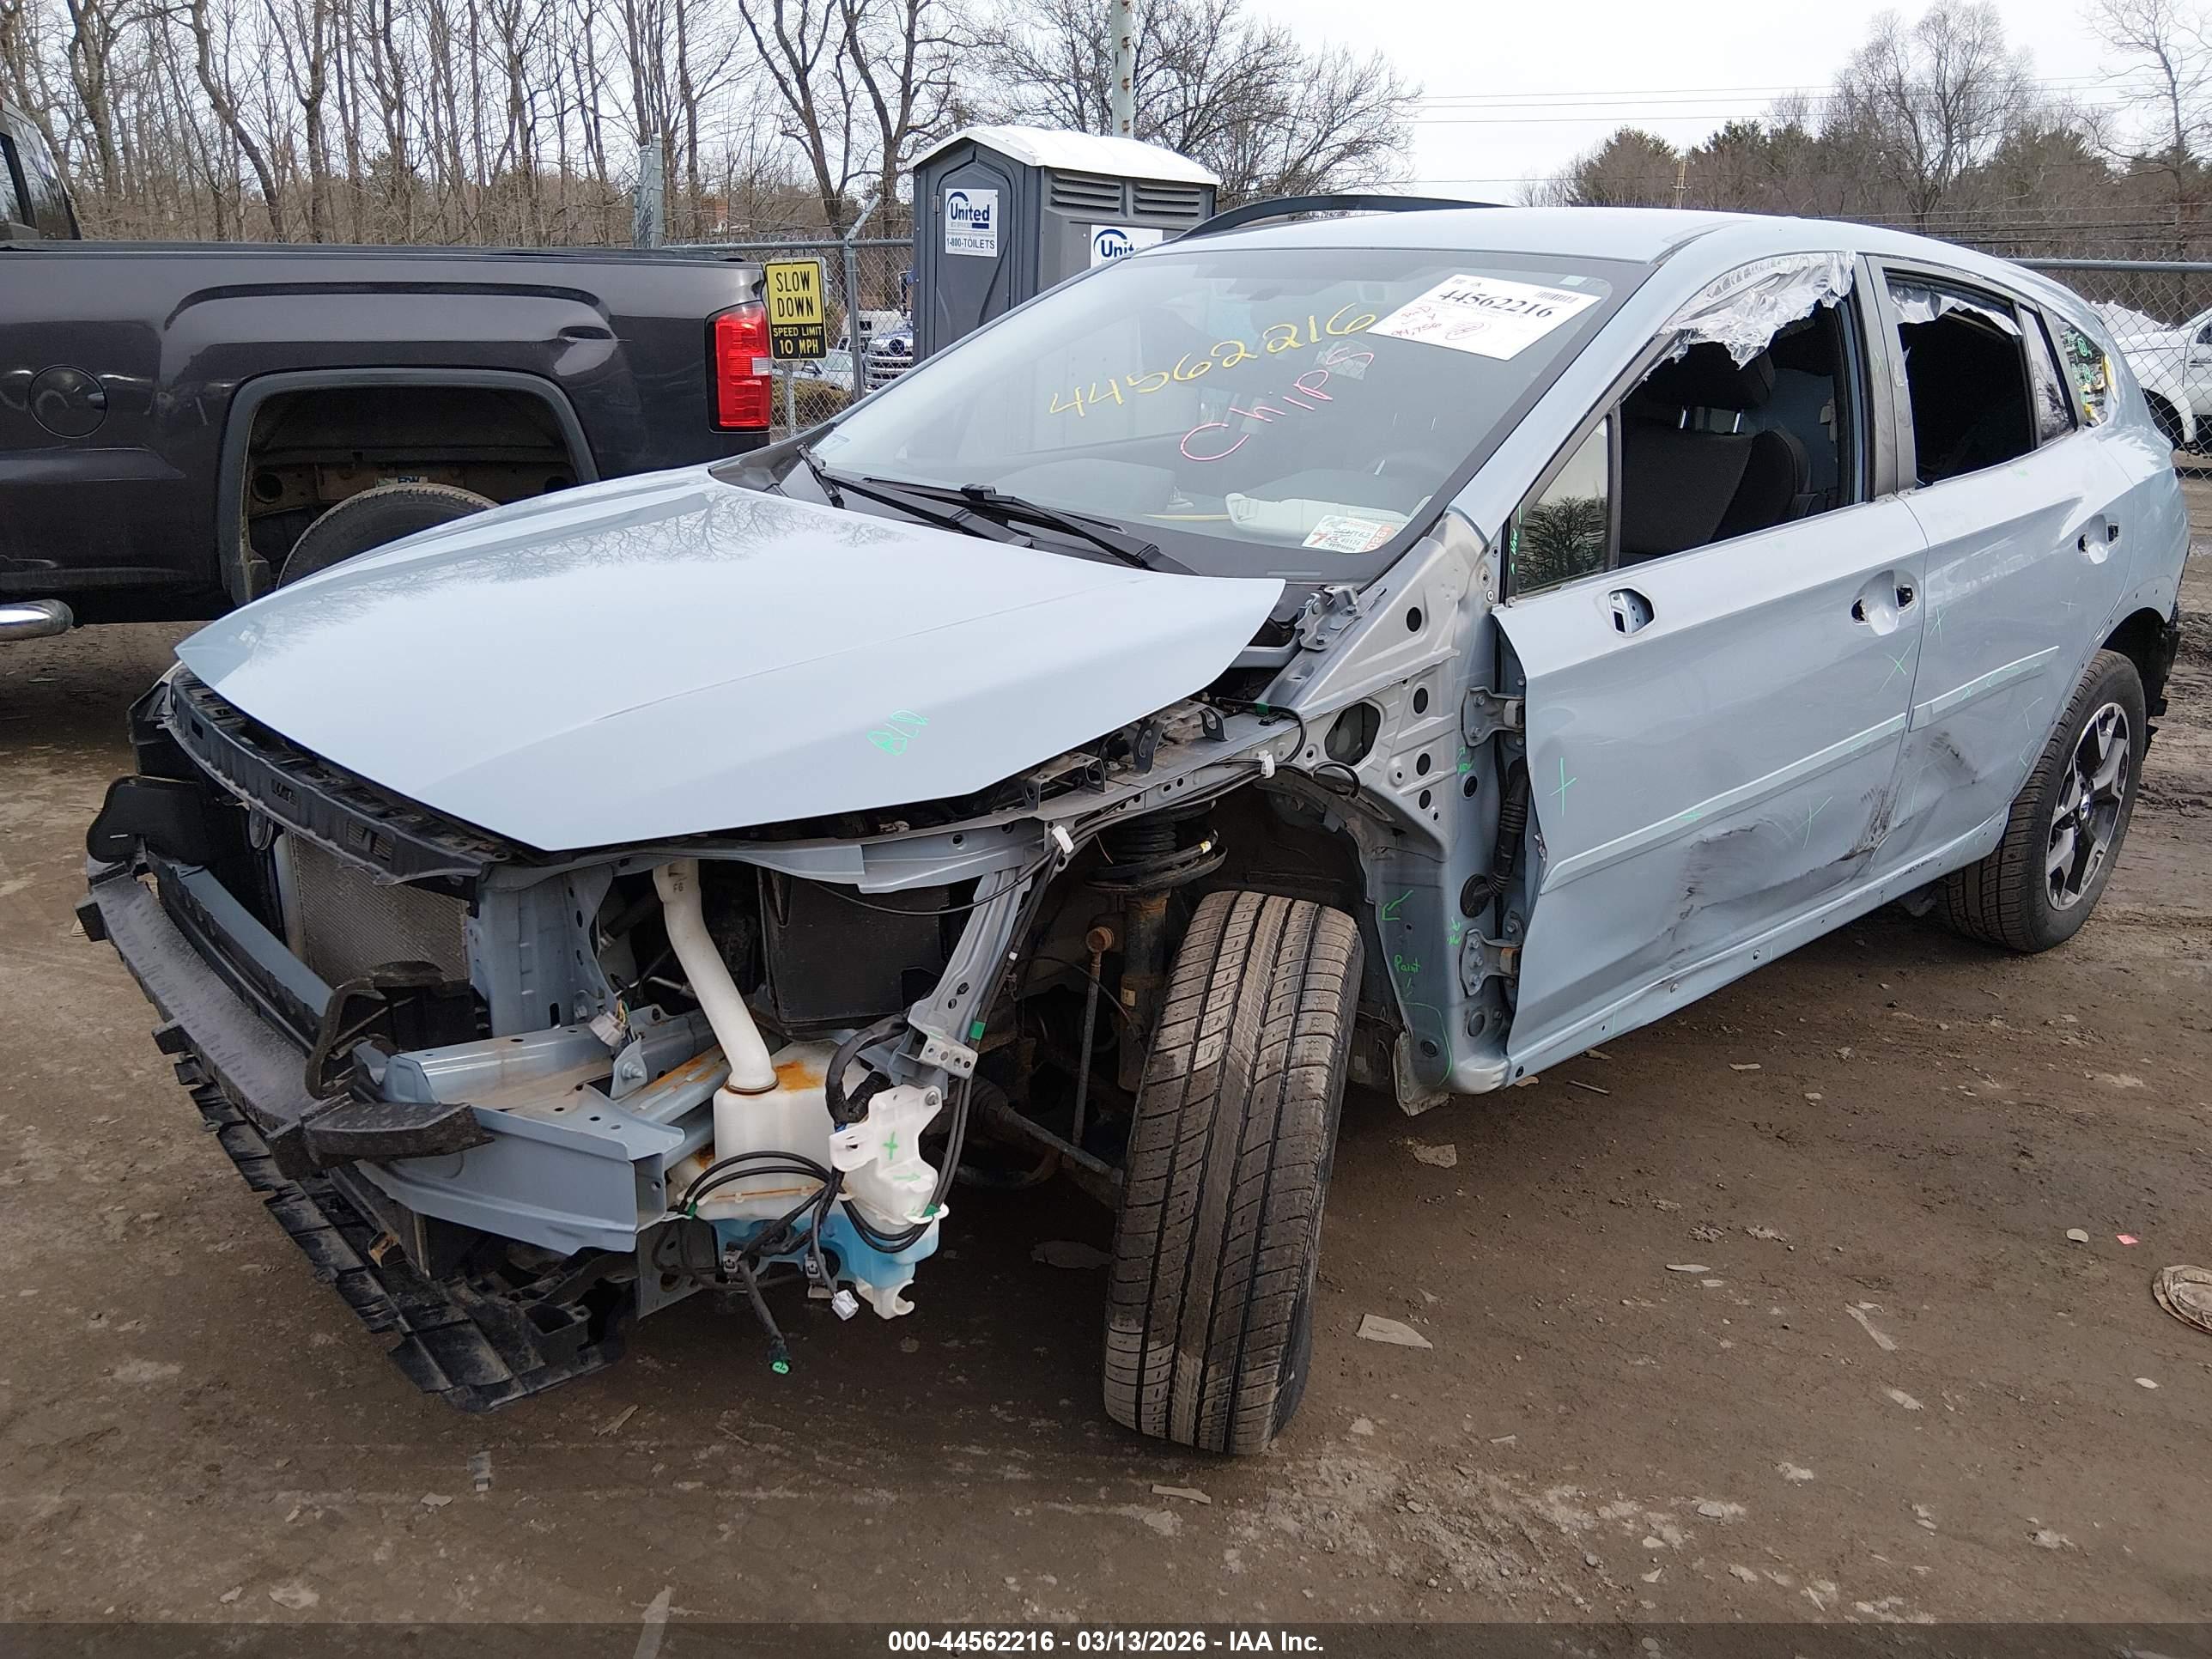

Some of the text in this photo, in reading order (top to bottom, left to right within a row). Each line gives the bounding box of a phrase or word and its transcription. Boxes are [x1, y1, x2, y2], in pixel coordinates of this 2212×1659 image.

[950, 202, 990, 222] United
[946, 238, 995, 250] 1-800-TOILETS
[775, 270, 810, 293] SLOW
[777, 296, 814, 318] DOWN
[1438, 289, 1561, 318] 44562216
[773, 325, 823, 337] SPEED LIMIT
[779, 338, 819, 355] 10 MPH
[1048, 302, 1376, 417] 44562216
